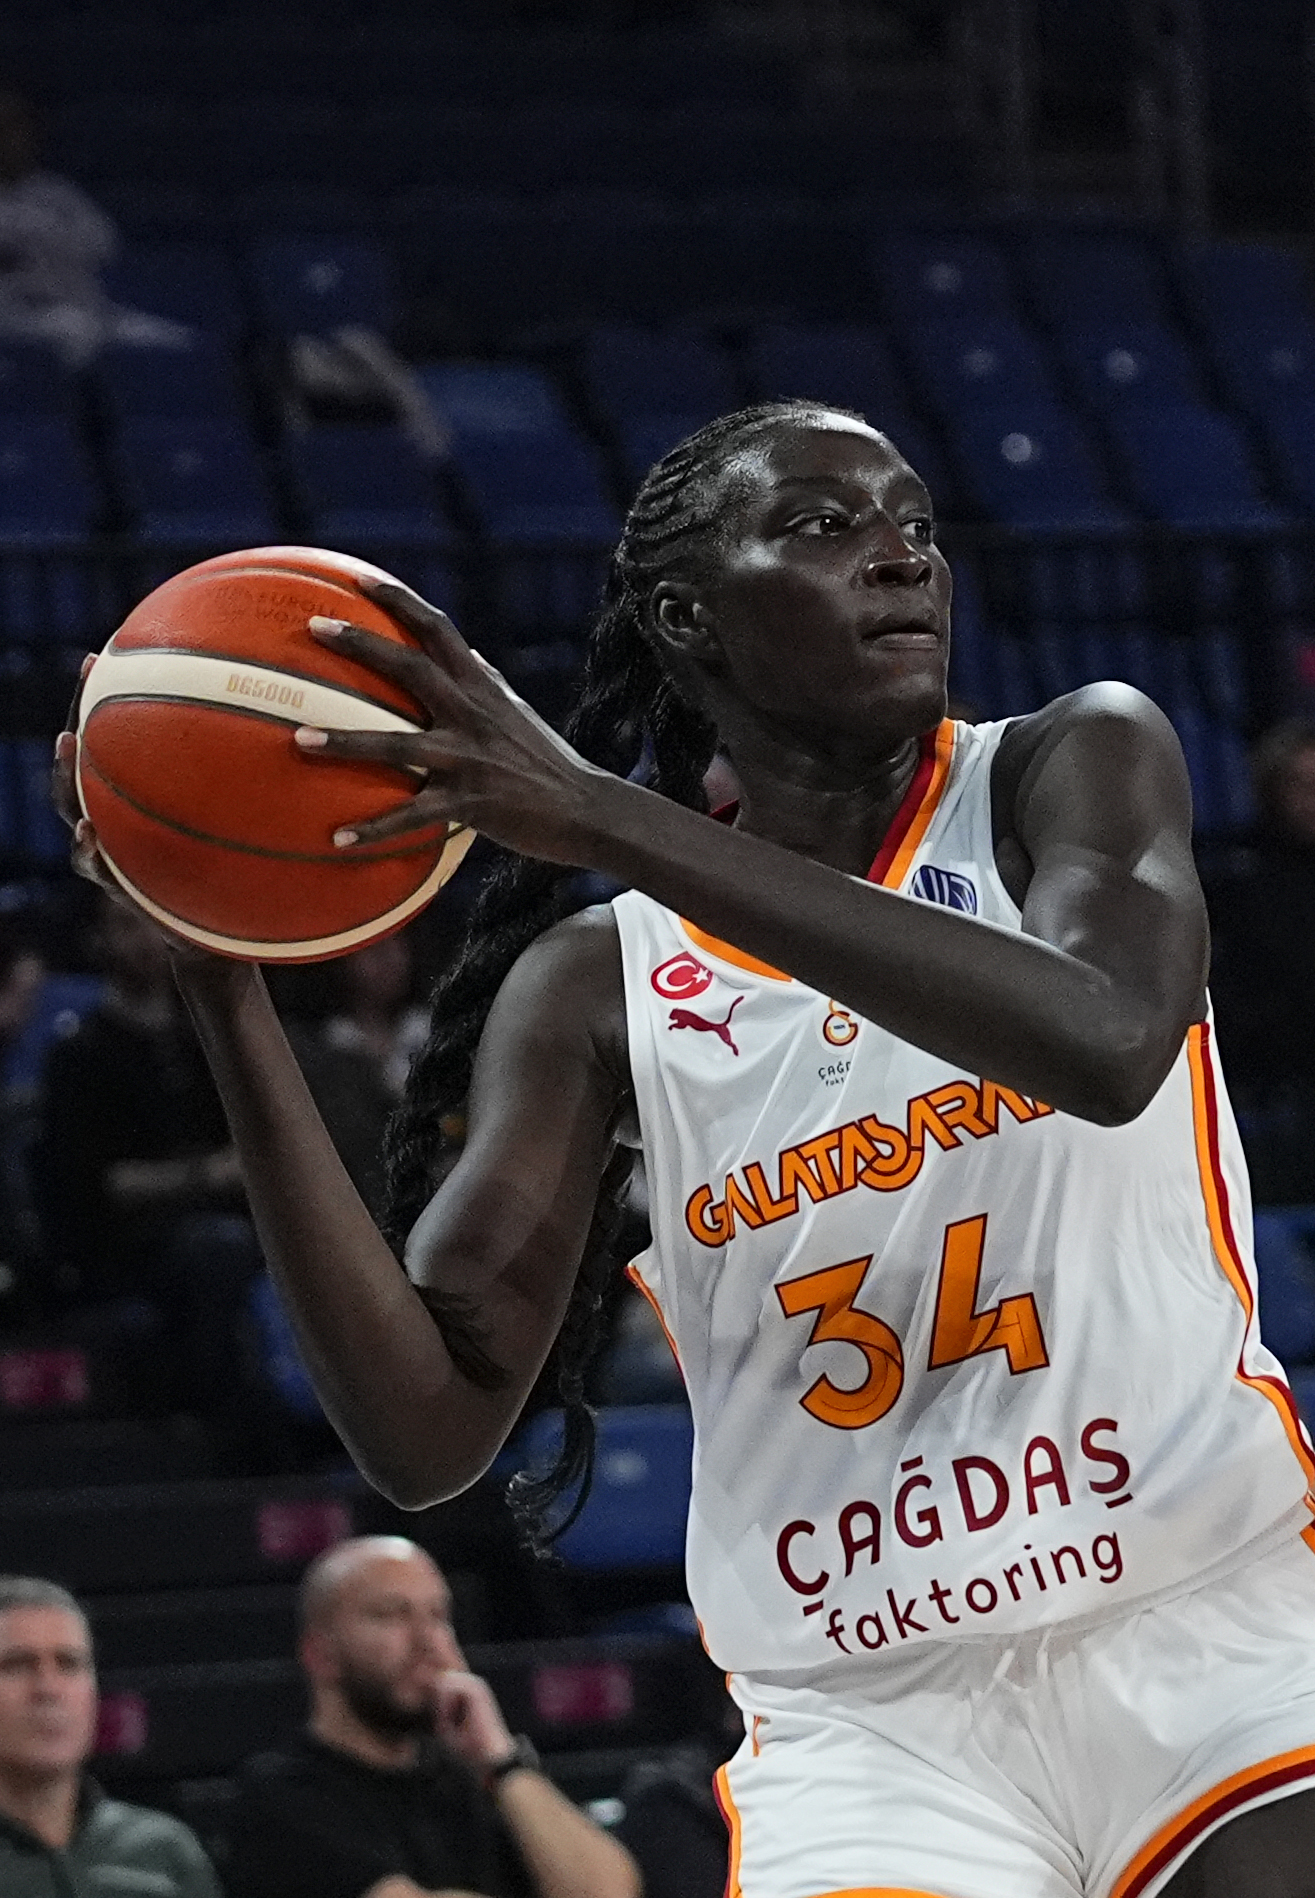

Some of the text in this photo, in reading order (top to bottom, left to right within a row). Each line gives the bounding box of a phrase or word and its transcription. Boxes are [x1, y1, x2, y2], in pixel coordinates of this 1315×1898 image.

[685, 1077, 1056, 1248] GALATASARA
[774, 1212, 1050, 1430] 34
[776, 1417, 1134, 1617] ÇAĞDAŞ
[825, 1530, 1124, 1655] faktoring
